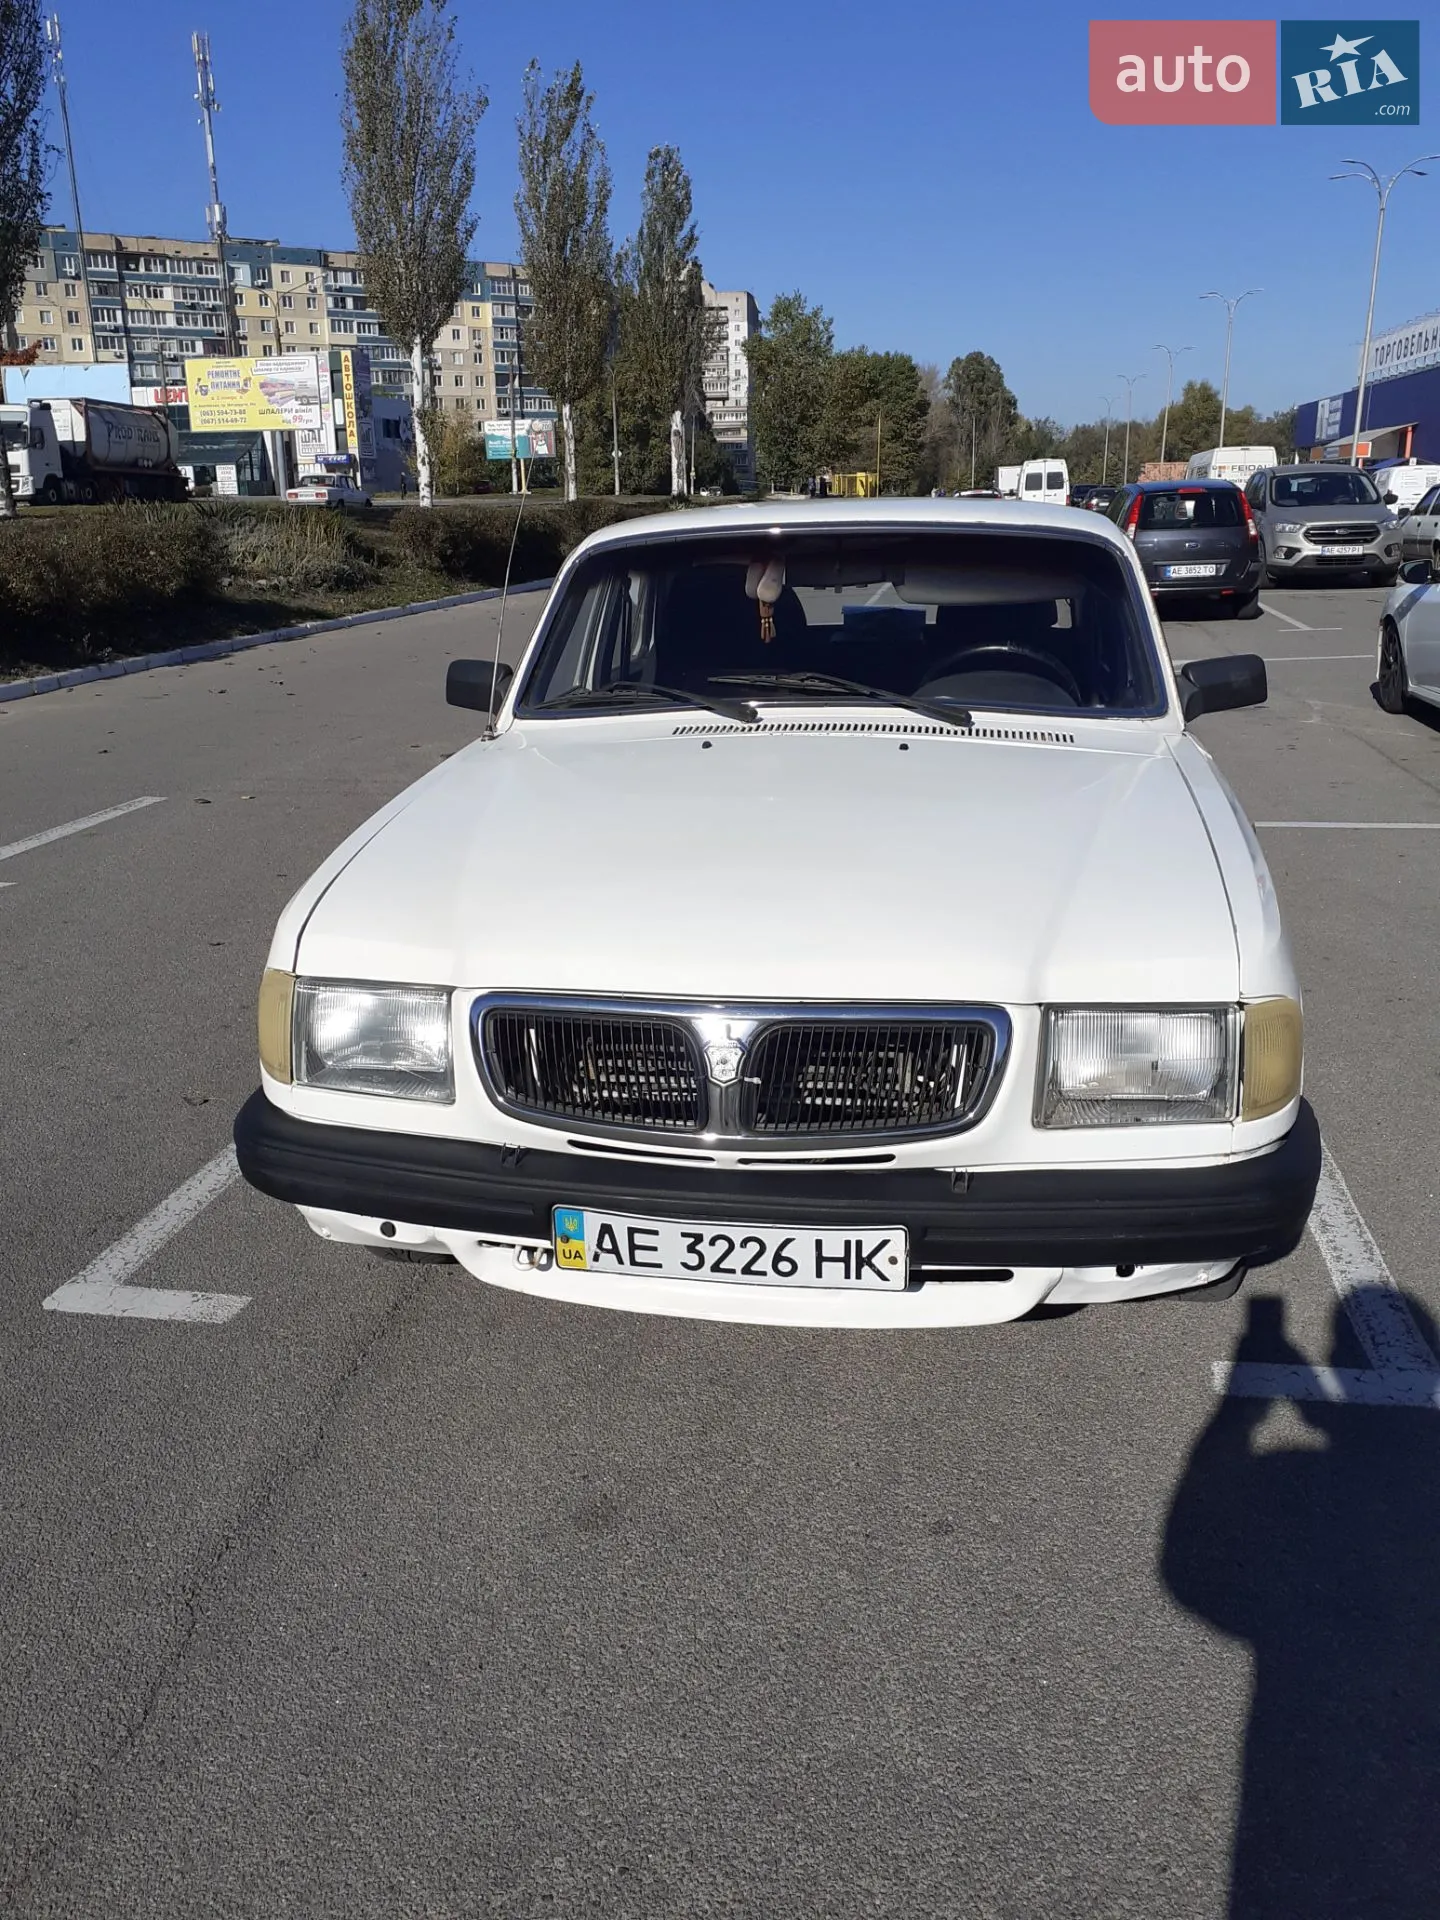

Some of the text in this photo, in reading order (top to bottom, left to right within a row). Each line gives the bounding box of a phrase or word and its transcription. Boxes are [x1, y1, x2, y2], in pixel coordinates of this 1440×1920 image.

[1375, 326, 1440, 367] ТОРГОВЕЛЬН
[343, 354, 356, 438] АВТОШКОЛА
[1171, 565, 1215, 575] AE 3852 TO
[562, 1248, 585, 1261] UA
[592, 1223, 891, 1282] AE 3226 HK
